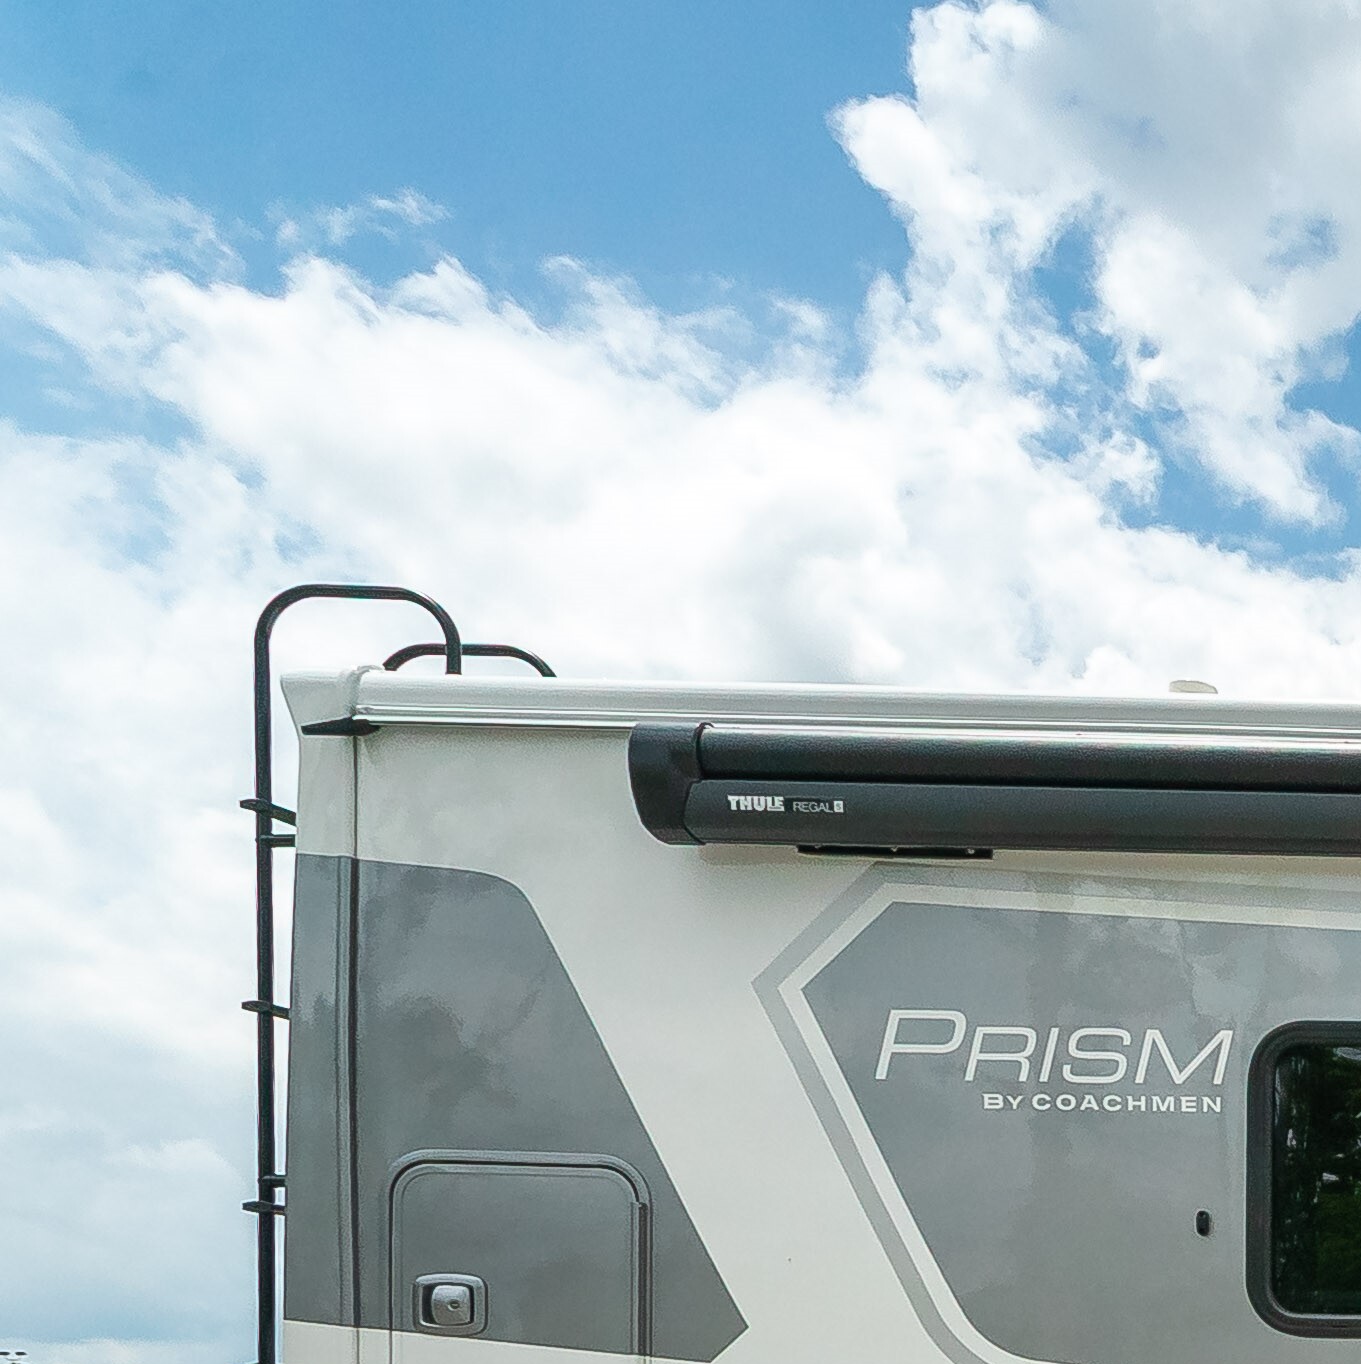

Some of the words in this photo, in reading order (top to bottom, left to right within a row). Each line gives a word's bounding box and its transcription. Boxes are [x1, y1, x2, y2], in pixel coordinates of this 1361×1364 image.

[727, 795, 785, 812] THULE
[792, 801, 833, 813] REGAL
[875, 1009, 1234, 1085] PRISM
[982, 1093, 1023, 1111] BY
[1032, 1094, 1222, 1113] COACHMEN
